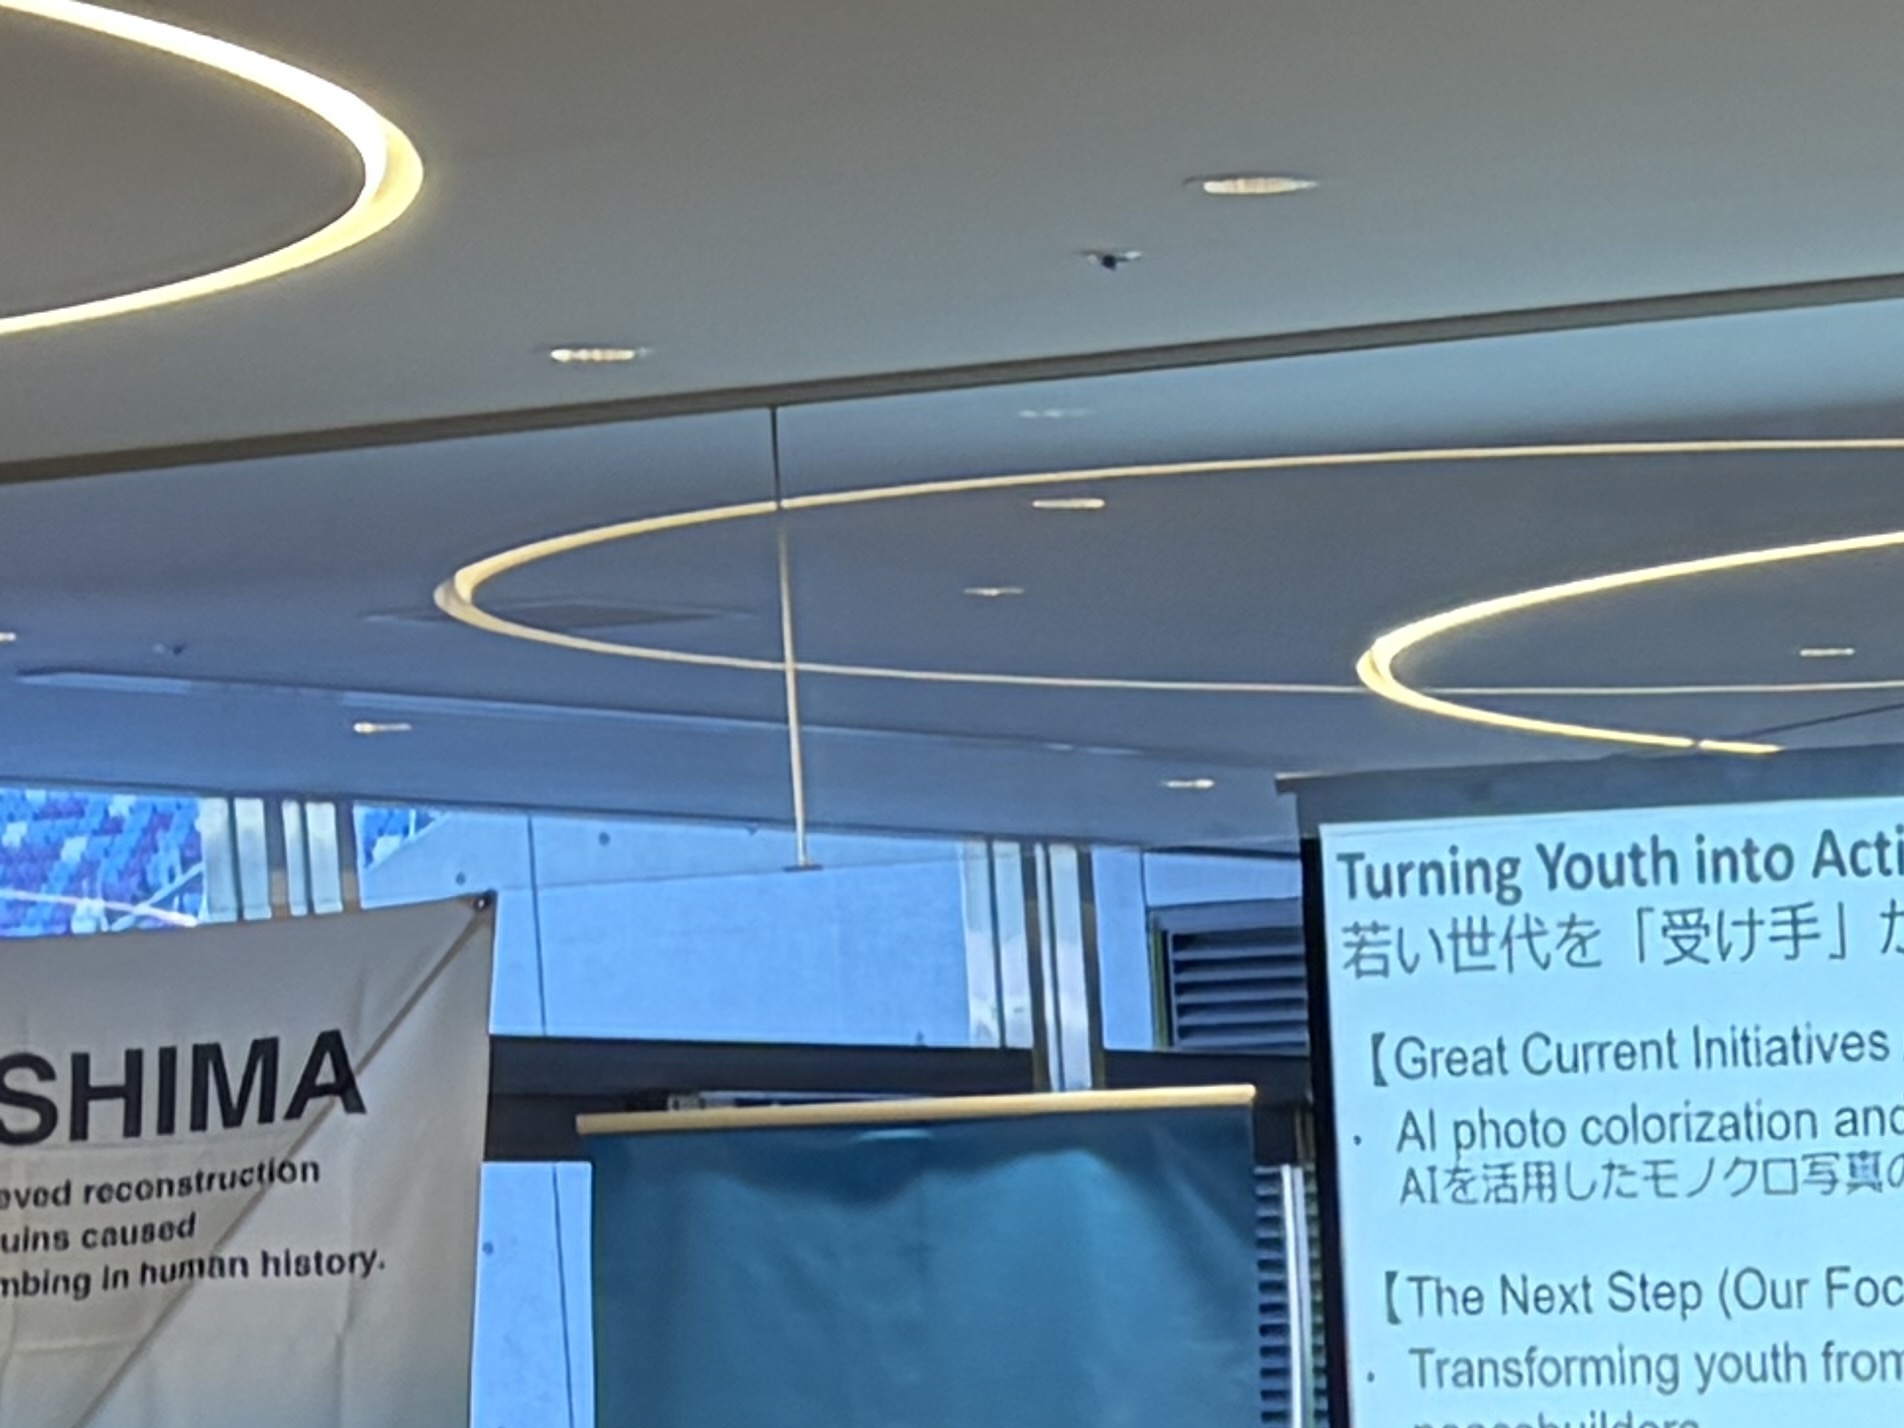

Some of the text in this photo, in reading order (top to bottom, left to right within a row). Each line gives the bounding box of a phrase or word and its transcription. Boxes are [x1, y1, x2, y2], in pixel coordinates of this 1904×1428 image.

[1338, 845, 1522, 906] Turning
[1536, 834, 1678, 891] Youth
[1696, 834, 1794, 884] into
[1522, 1028, 1679, 1076] Current
[1693, 1021, 1890, 1069] Initiatives
[0, 1028, 366, 1146] SHIMA
[1396, 1108, 1436, 1153] AI
[1452, 1106, 1567, 1162] photo
[1581, 1098, 1817, 1146] colorization
[84, 1157, 321, 1206] reconstruction
[81, 1211, 197, 1250] caused
[102, 1264, 129, 1291] in
[140, 1255, 249, 1287] human
[261, 1248, 385, 1279] history.
[1500, 1273, 1593, 1315] Next
[1608, 1270, 1703, 1322] Step
[1719, 1266, 1810, 1320] (Our
[1408, 1343, 1679, 1396] Transforming
[1694, 1341, 1807, 1395] youth
